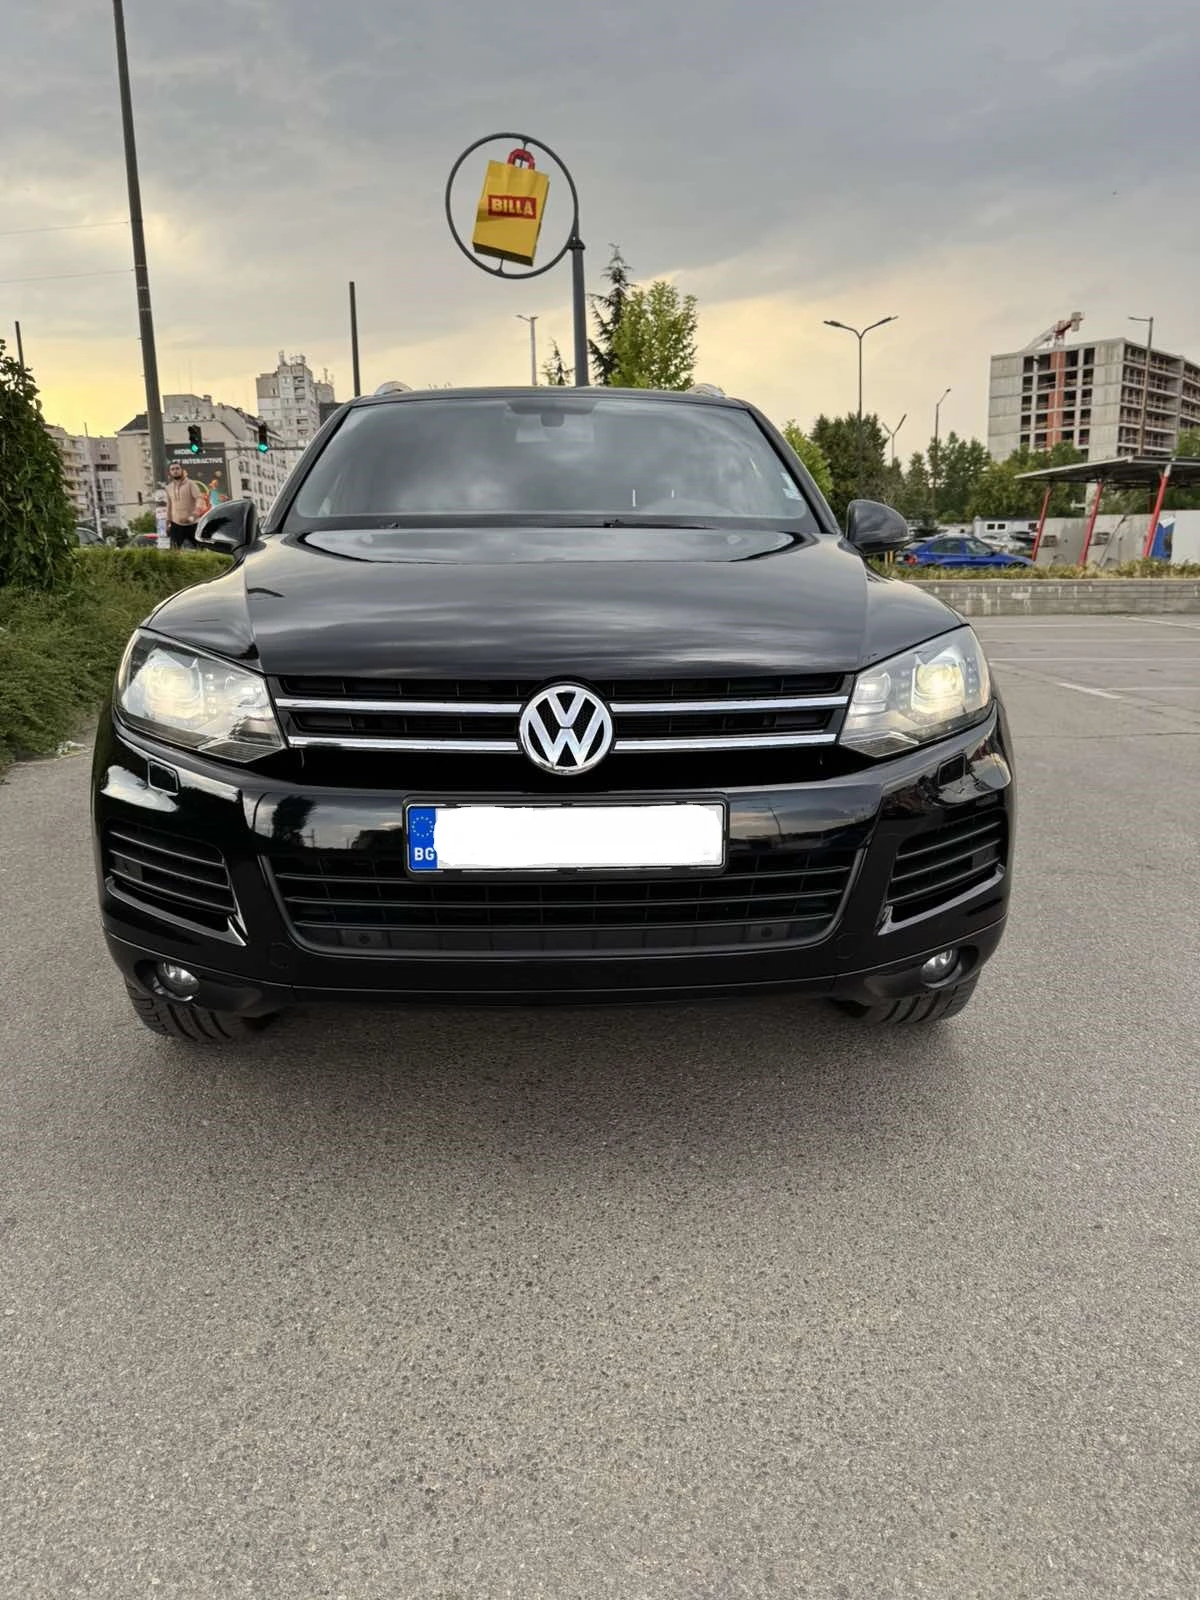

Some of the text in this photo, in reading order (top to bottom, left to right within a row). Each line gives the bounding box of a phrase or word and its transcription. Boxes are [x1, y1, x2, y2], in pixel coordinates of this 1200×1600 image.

[491, 198, 534, 216] BILLA
[181, 457, 223, 465] INTERACTIVE
[524, 688, 608, 770] VW
[414, 847, 435, 861] BG
